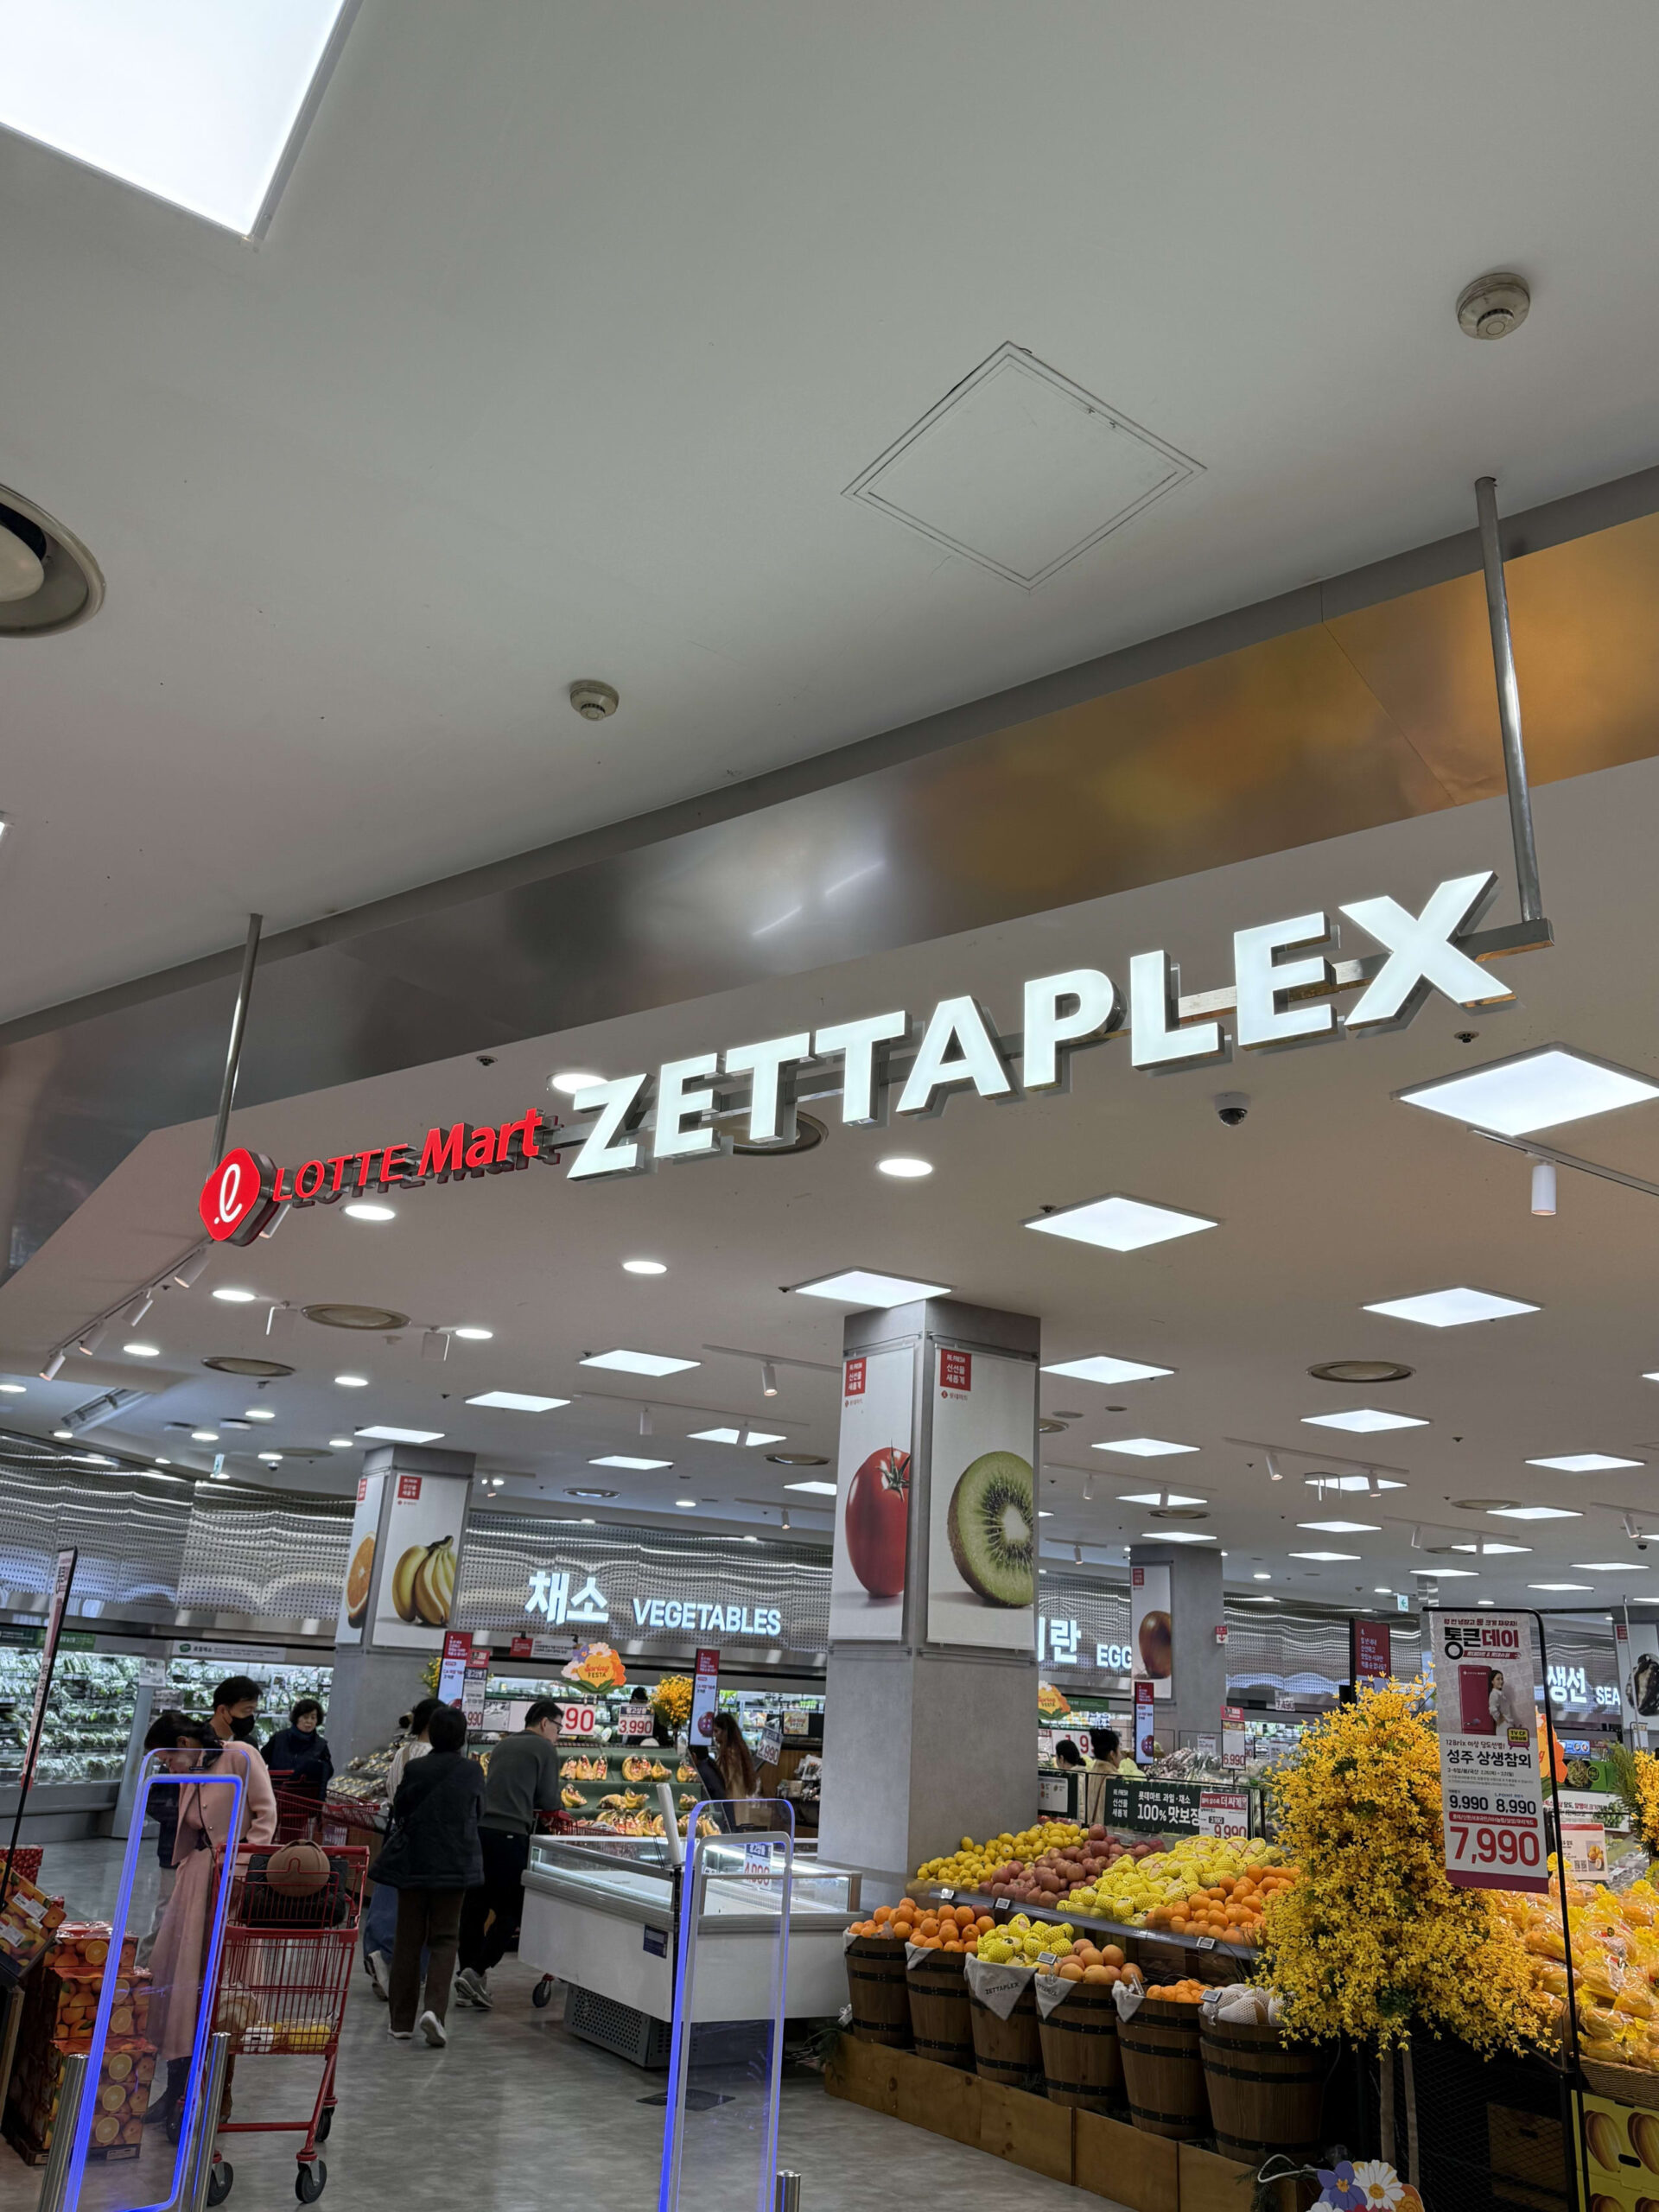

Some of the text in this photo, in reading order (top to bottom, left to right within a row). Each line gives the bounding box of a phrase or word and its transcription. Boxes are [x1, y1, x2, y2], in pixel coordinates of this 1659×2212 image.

[567, 870, 1513, 1180] ZETTAPLEX
[271, 1107, 543, 1203] LOTTE Mart
[946, 1363, 966, 1376] 신선을
[524, 1570, 609, 1625] 채소
[632, 1598, 781, 1637] VEGETABLES
[1039, 1617, 1082, 1664] 란
[1444, 1626, 1520, 1660] 통큰데이
[1096, 1643, 1132, 1669] EGG
[584, 1663, 610, 1674] Spring
[1548, 1665, 1587, 1704] 생선
[1595, 1685, 1621, 1706] SEA
[464, 1711, 483, 1726] 990
[619, 1719, 652, 1734] 3,990
[1446, 1738, 1466, 1747] 12Brix
[1223, 1752, 1245, 1766] 6,990
[1446, 1749, 1474, 1765] 성주
[1477, 1751, 1532, 1769] 상생참외
[1138, 1790, 1161, 1802] 롯데마트
[1449, 1795, 1489, 1811] 9,990
[1496, 1798, 1537, 1815] 8,990
[1137, 1802, 1167, 1822] 100%
[1214, 1823, 1247, 1840] 9990
[1449, 1825, 1541, 1867] 7,990
[985, 1981, 1020, 1995] ZETTAPLEX
